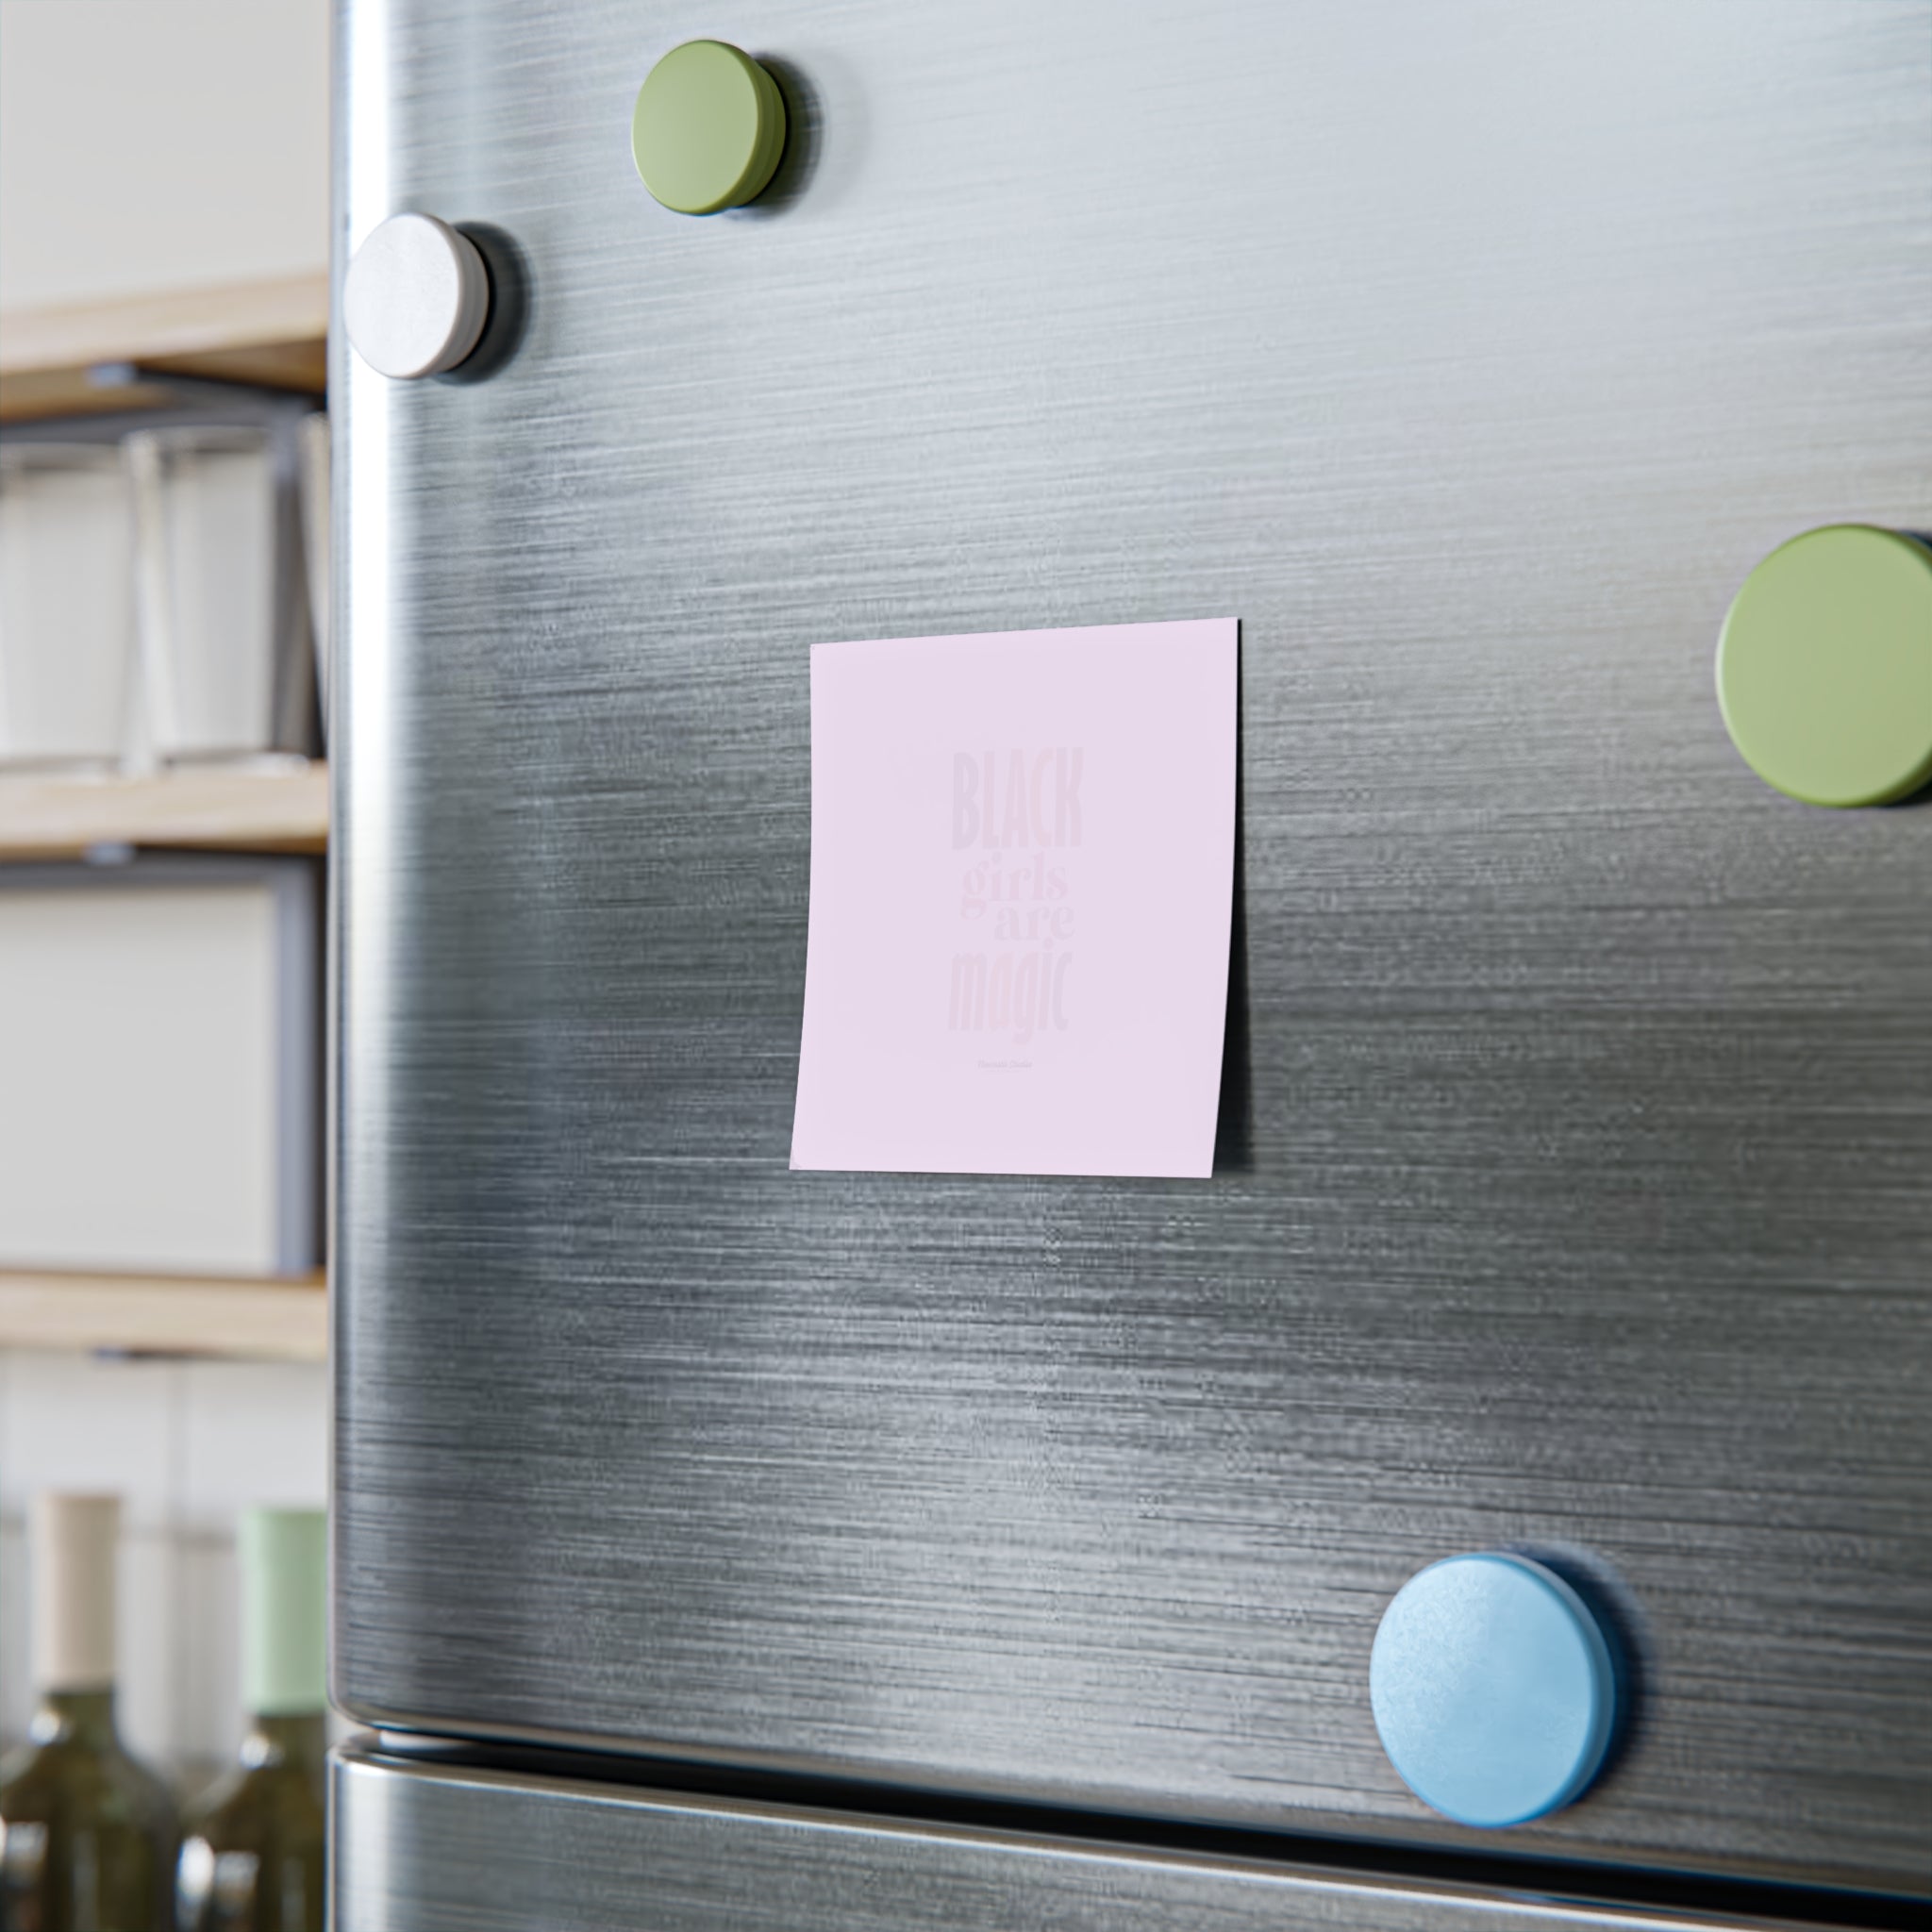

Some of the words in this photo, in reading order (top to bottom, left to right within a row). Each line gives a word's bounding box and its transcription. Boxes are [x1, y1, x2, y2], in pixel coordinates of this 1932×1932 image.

[952, 747, 1084, 849] BLACK
[960, 851, 1070, 919] girls
[994, 907, 1075, 940] are
[949, 936, 1073, 1044] magic
